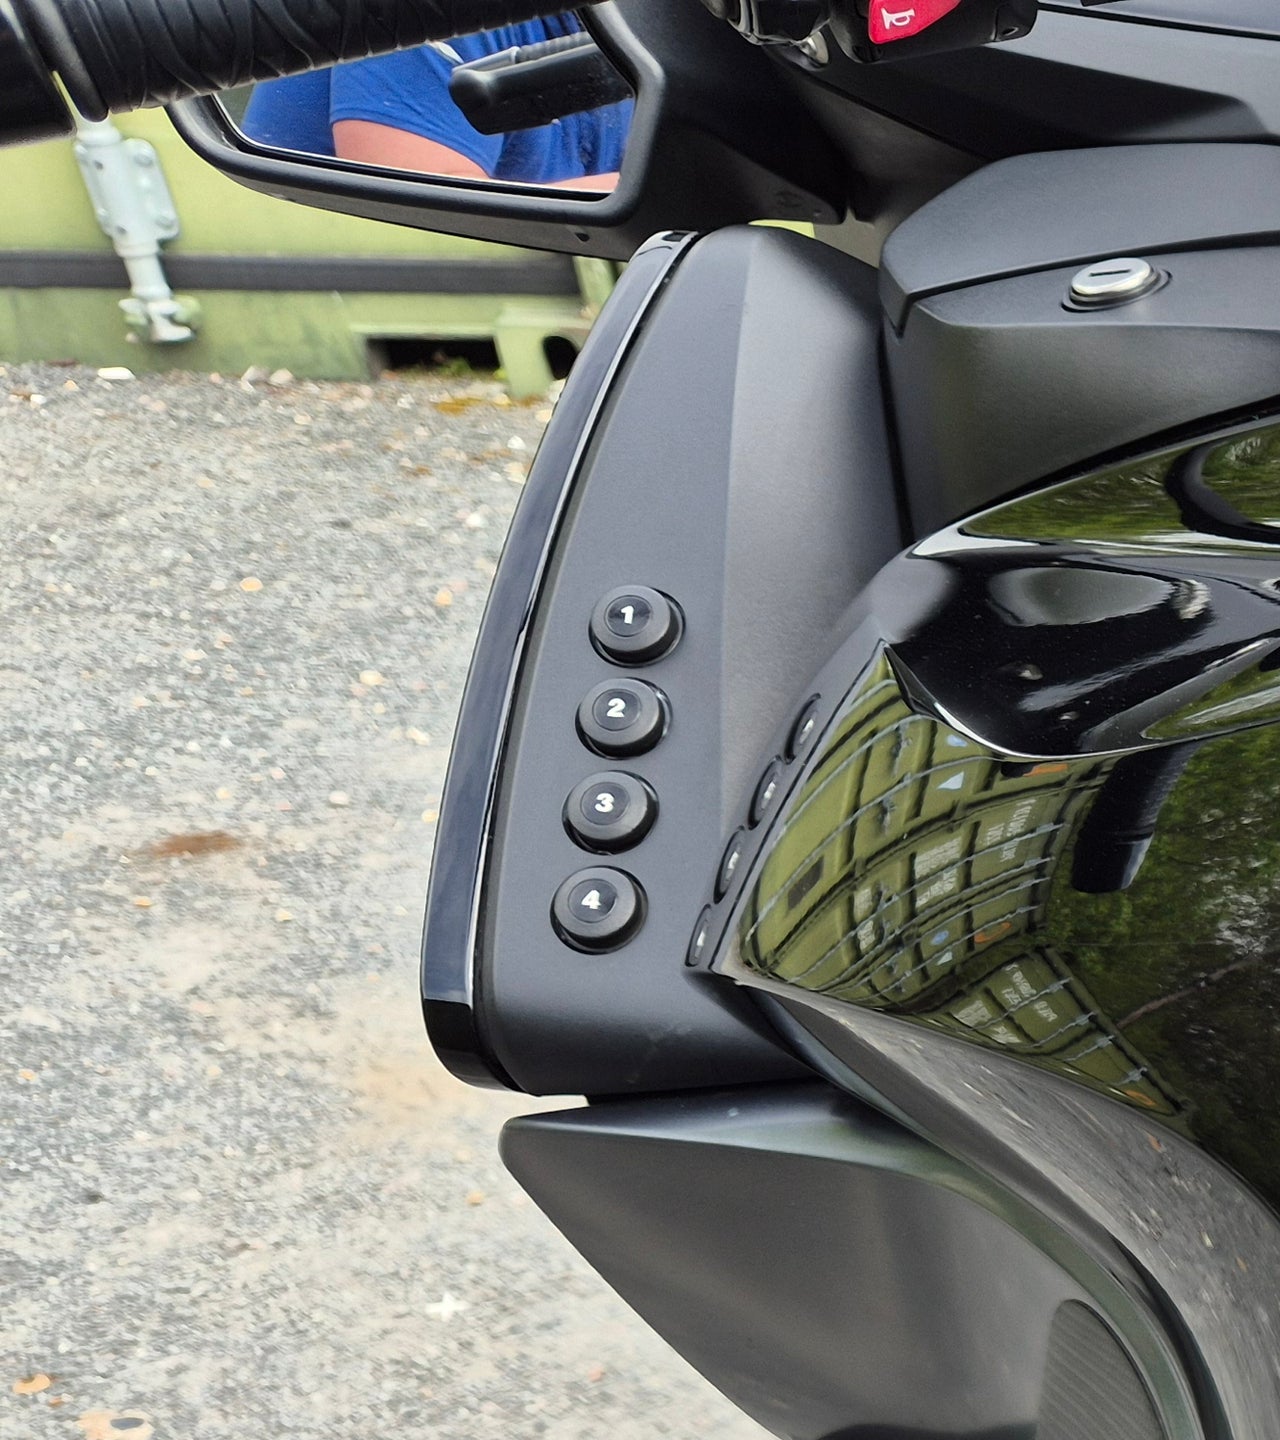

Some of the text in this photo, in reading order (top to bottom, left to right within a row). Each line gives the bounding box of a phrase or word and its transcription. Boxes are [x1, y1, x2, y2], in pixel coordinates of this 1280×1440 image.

[619, 604, 635, 625] 1
[605, 697, 626, 718] 2
[595, 793, 614, 812] 3
[581, 890, 600, 909] 4
